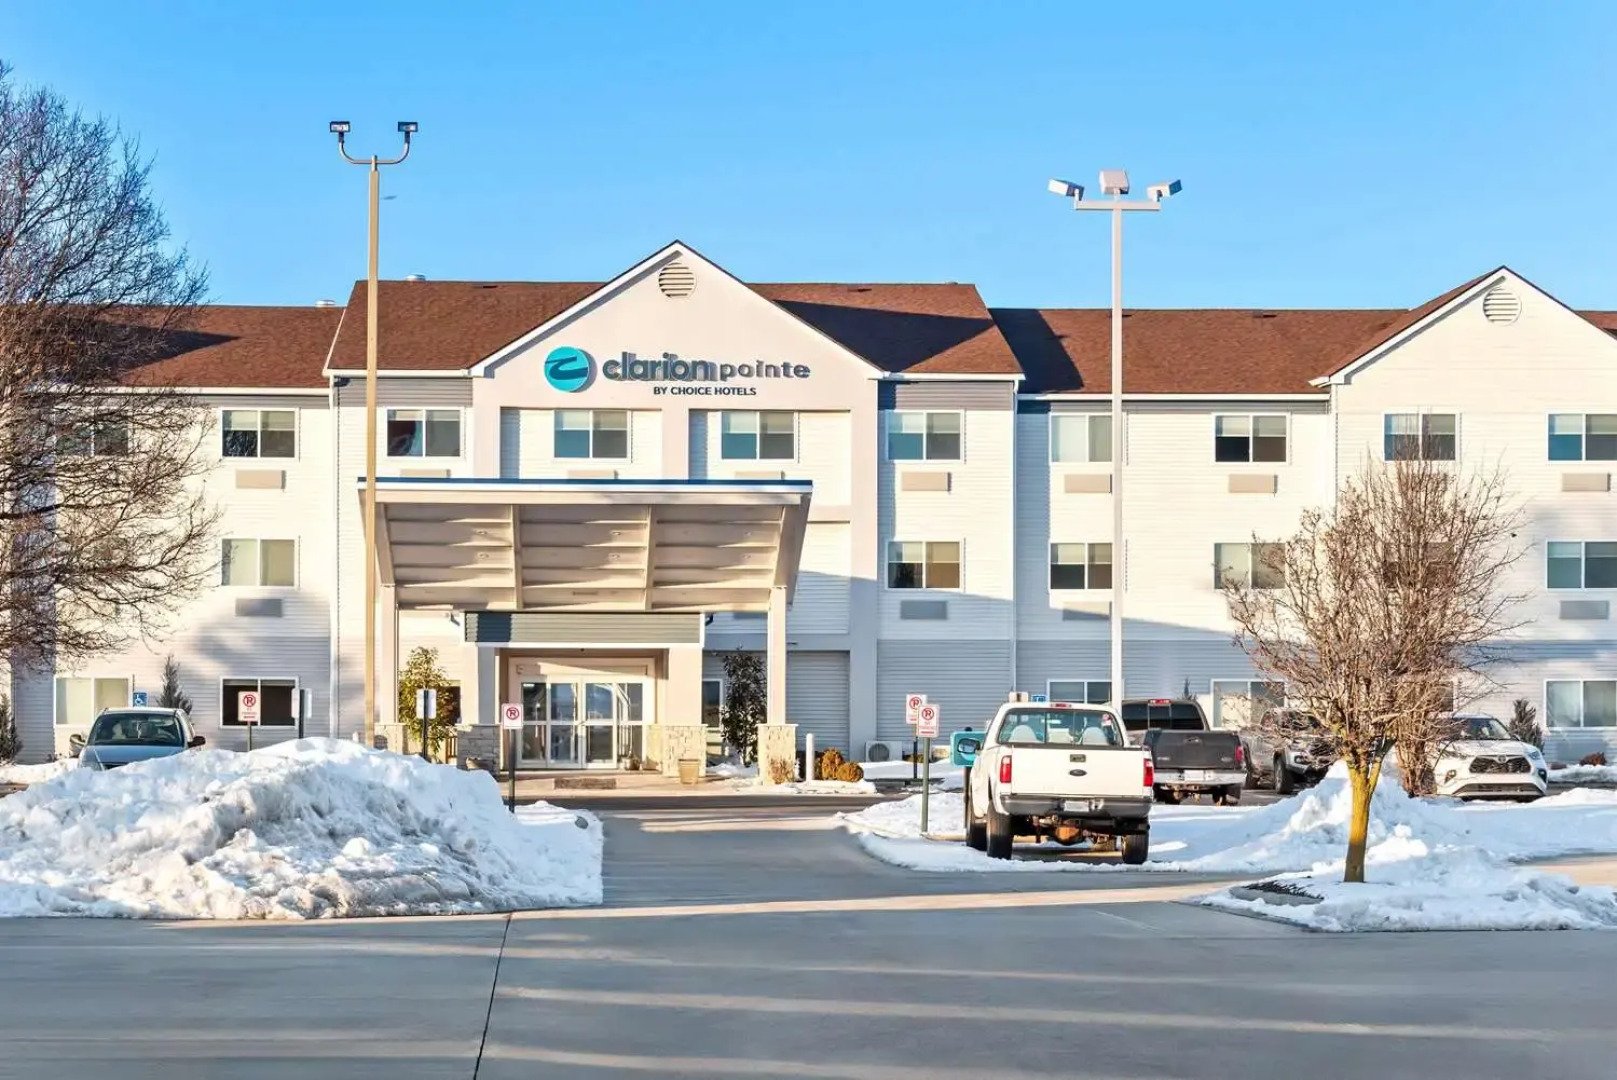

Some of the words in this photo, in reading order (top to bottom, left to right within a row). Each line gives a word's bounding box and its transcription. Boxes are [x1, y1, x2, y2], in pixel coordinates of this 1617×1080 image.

[602, 351, 717, 382] clarion
[720, 359, 811, 382] pointe
[653, 386, 668, 395] BY
[670, 386, 712, 396] CHOICE
[714, 386, 757, 396] HOTELS
